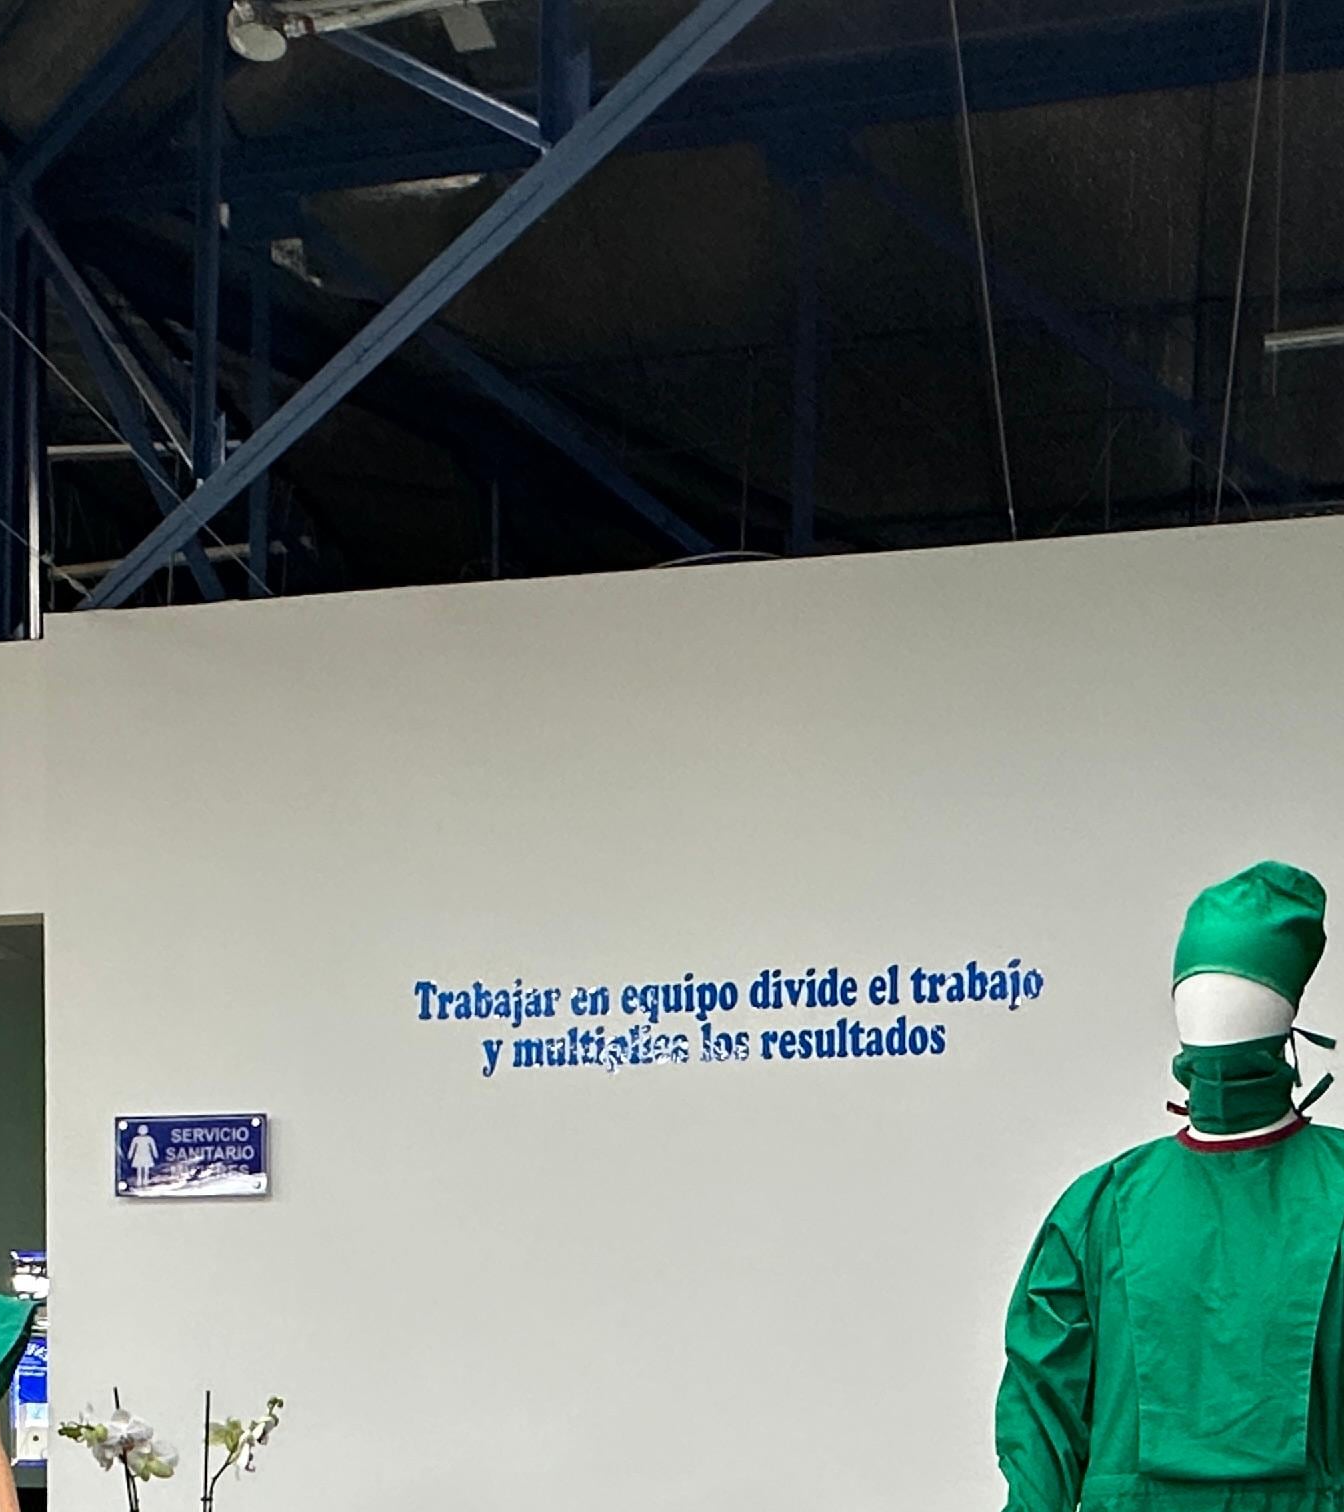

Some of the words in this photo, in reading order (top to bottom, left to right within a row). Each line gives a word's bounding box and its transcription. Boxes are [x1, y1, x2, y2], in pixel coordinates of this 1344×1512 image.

[414, 978, 561, 1028] Trabajar
[571, 986, 610, 1016] en
[621, 972, 738, 1023] equipo
[749, 968, 858, 1009] divide
[868, 965, 899, 1006] el
[910, 958, 1044, 1011] trabajo
[482, 1038, 503, 1077] y
[700, 1022, 750, 1063] los
[760, 1015, 946, 1060] resultados
[165, 1145, 255, 1162] SANITARIO
[170, 1126, 250, 1144] SERVICIO
